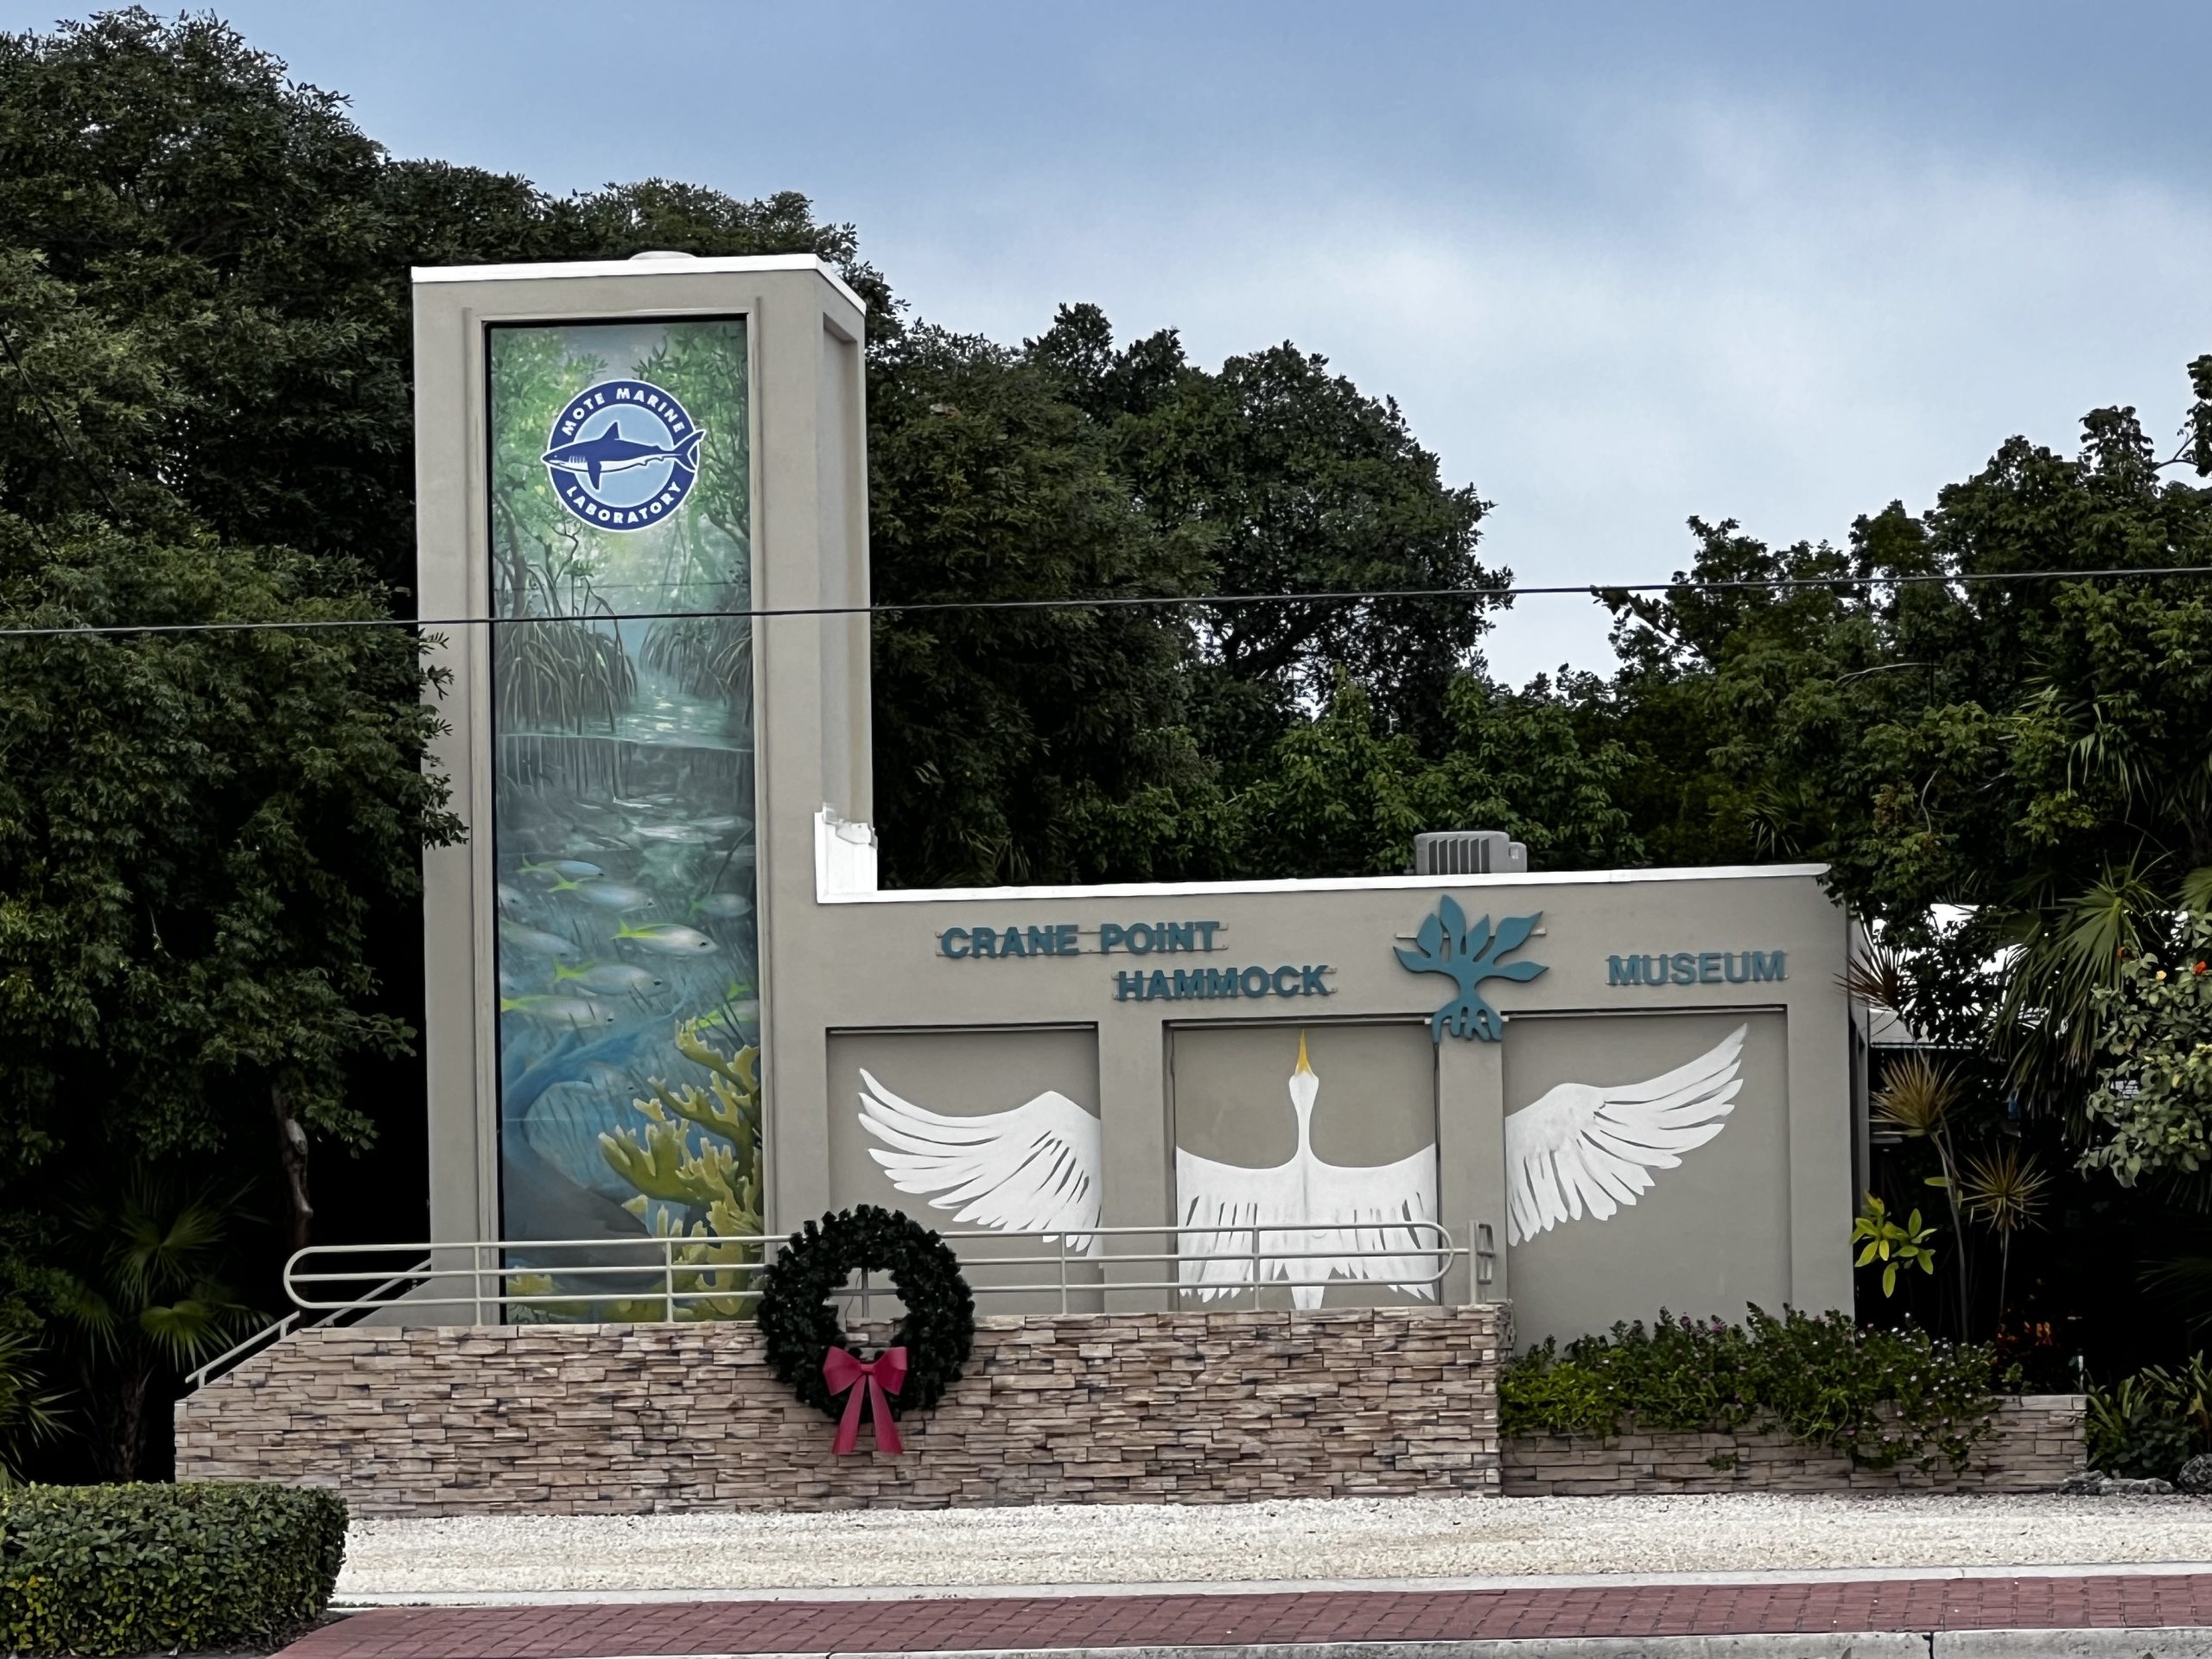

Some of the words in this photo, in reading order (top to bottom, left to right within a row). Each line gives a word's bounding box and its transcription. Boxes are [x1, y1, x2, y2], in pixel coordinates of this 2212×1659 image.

[562, 392, 605, 435] MOTE
[616, 388, 685, 433] MARINE
[566, 481, 681, 524] LABORATORY
[940, 924, 1079, 958] CRANE
[1100, 921, 1220, 955] POINT
[1118, 964, 1330, 1001] HAMMOCK
[1608, 950, 1786, 986] MUSEUM
